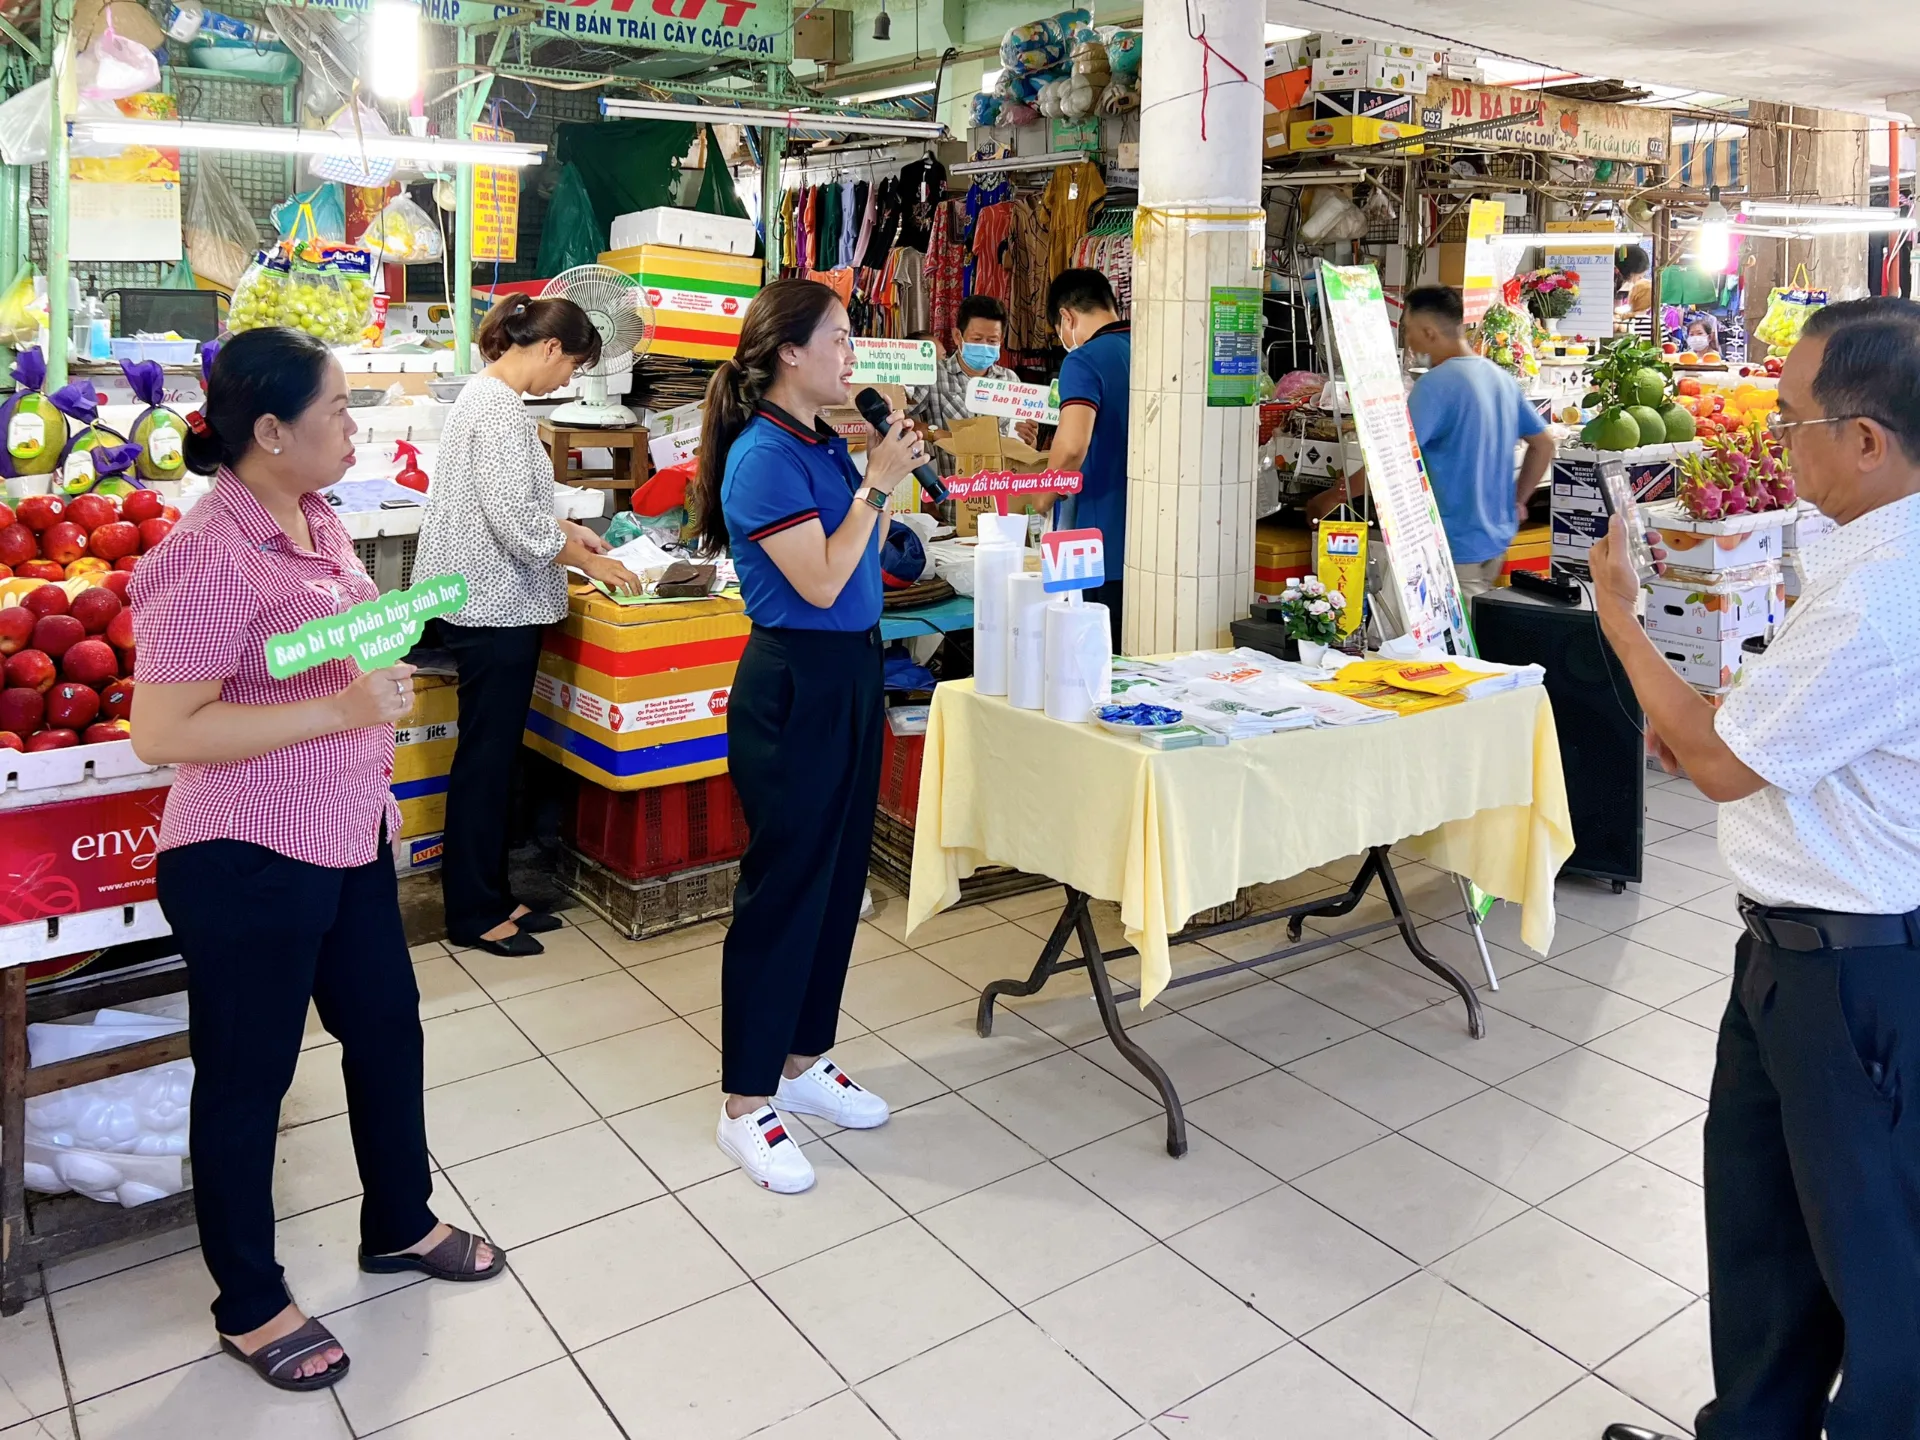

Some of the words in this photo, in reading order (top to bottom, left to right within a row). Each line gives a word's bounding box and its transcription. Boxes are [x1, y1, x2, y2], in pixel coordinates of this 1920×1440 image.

[576, 9, 611, 35] BÁN
[617, 16, 656, 41] TRÁI
[663, 21, 697, 45] CÂY
[701, 25, 734, 50] CÁC
[738, 33, 774, 58] LOẠI
[1423, 110, 1441, 124] 092
[1650, 140, 1662, 153] 073
[723, 302, 737, 310] STOP
[977, 380, 994, 389] Bao
[992, 394, 1009, 404] Bao
[1022, 398, 1044, 410] Sạch
[1015, 408, 1032, 417] Bao
[672, 453, 679, 462] 5
[948, 480, 971, 498] thay
[971, 474, 988, 493] đổi
[989, 475, 1009, 491] thói
[1011, 479, 1038, 494] quen
[1040, 474, 1052, 487] sử
[1053, 474, 1080, 490] dụng
[1328, 535, 1358, 553] VFP
[1041, 538, 1104, 582] VFP
[274, 642, 306, 667] Bao
[307, 629, 326, 653] bì
[328, 625, 345, 648] tự
[350, 612, 384, 643] phân
[385, 601, 410, 626] hủy
[412, 590, 438, 613] sinh
[440, 582, 463, 602] học
[1696, 627, 1702, 635] B
[359, 632, 405, 661] Vafaco
[646, 707, 668, 715] Package
[669, 702, 694, 711] Damaged
[711, 695, 729, 708] STOP
[609, 711, 621, 725] STOP
[636, 714, 652, 722] Check
[654, 710, 677, 718] Contents
[646, 718, 665, 726] Signing
[395, 730, 411, 744] itt
[72, 824, 160, 870] envy
